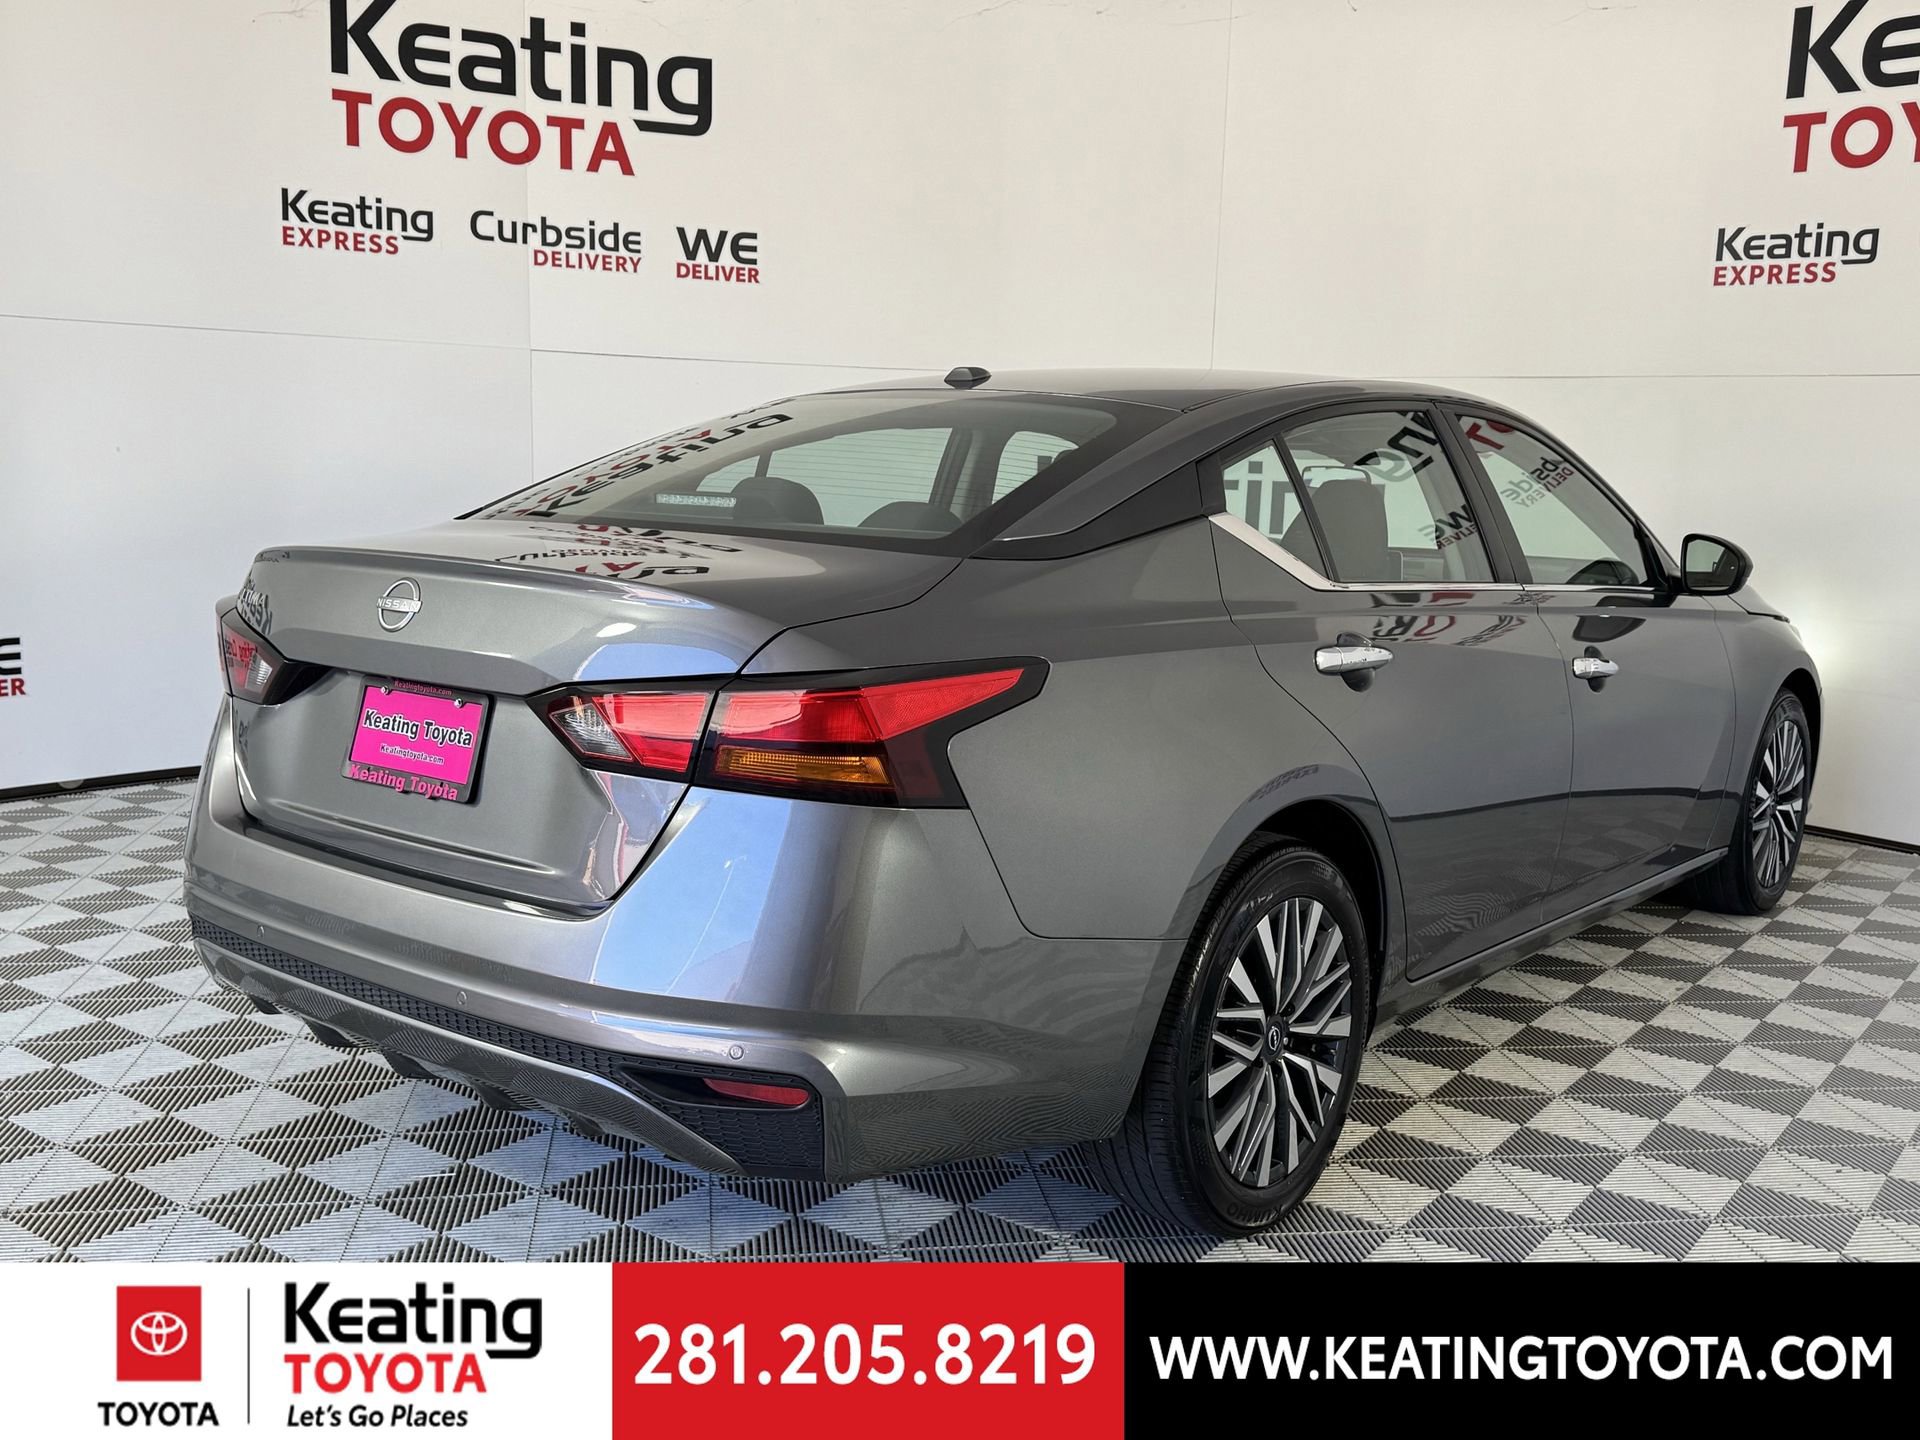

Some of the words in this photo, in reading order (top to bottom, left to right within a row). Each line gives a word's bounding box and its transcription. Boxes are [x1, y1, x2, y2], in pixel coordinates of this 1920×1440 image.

[330, 0, 713, 136] Keating
[331, 88, 635, 176] TOYOTA
[281, 187, 434, 242] Keating
[469, 209, 642, 254] Curbside
[282, 226, 399, 255] EXPRESS
[1715, 222, 1880, 264] Keating
[533, 249, 642, 273] DELIVERY
[676, 262, 760, 283] DELIVER
[1713, 261, 1837, 286] EXPRESS
[376, 597, 421, 612] NISSAN
[363, 709, 420, 740] Keating
[424, 720, 473, 747] Toyota
[348, 764, 406, 792] Keating
[410, 776, 458, 800] Toyota
